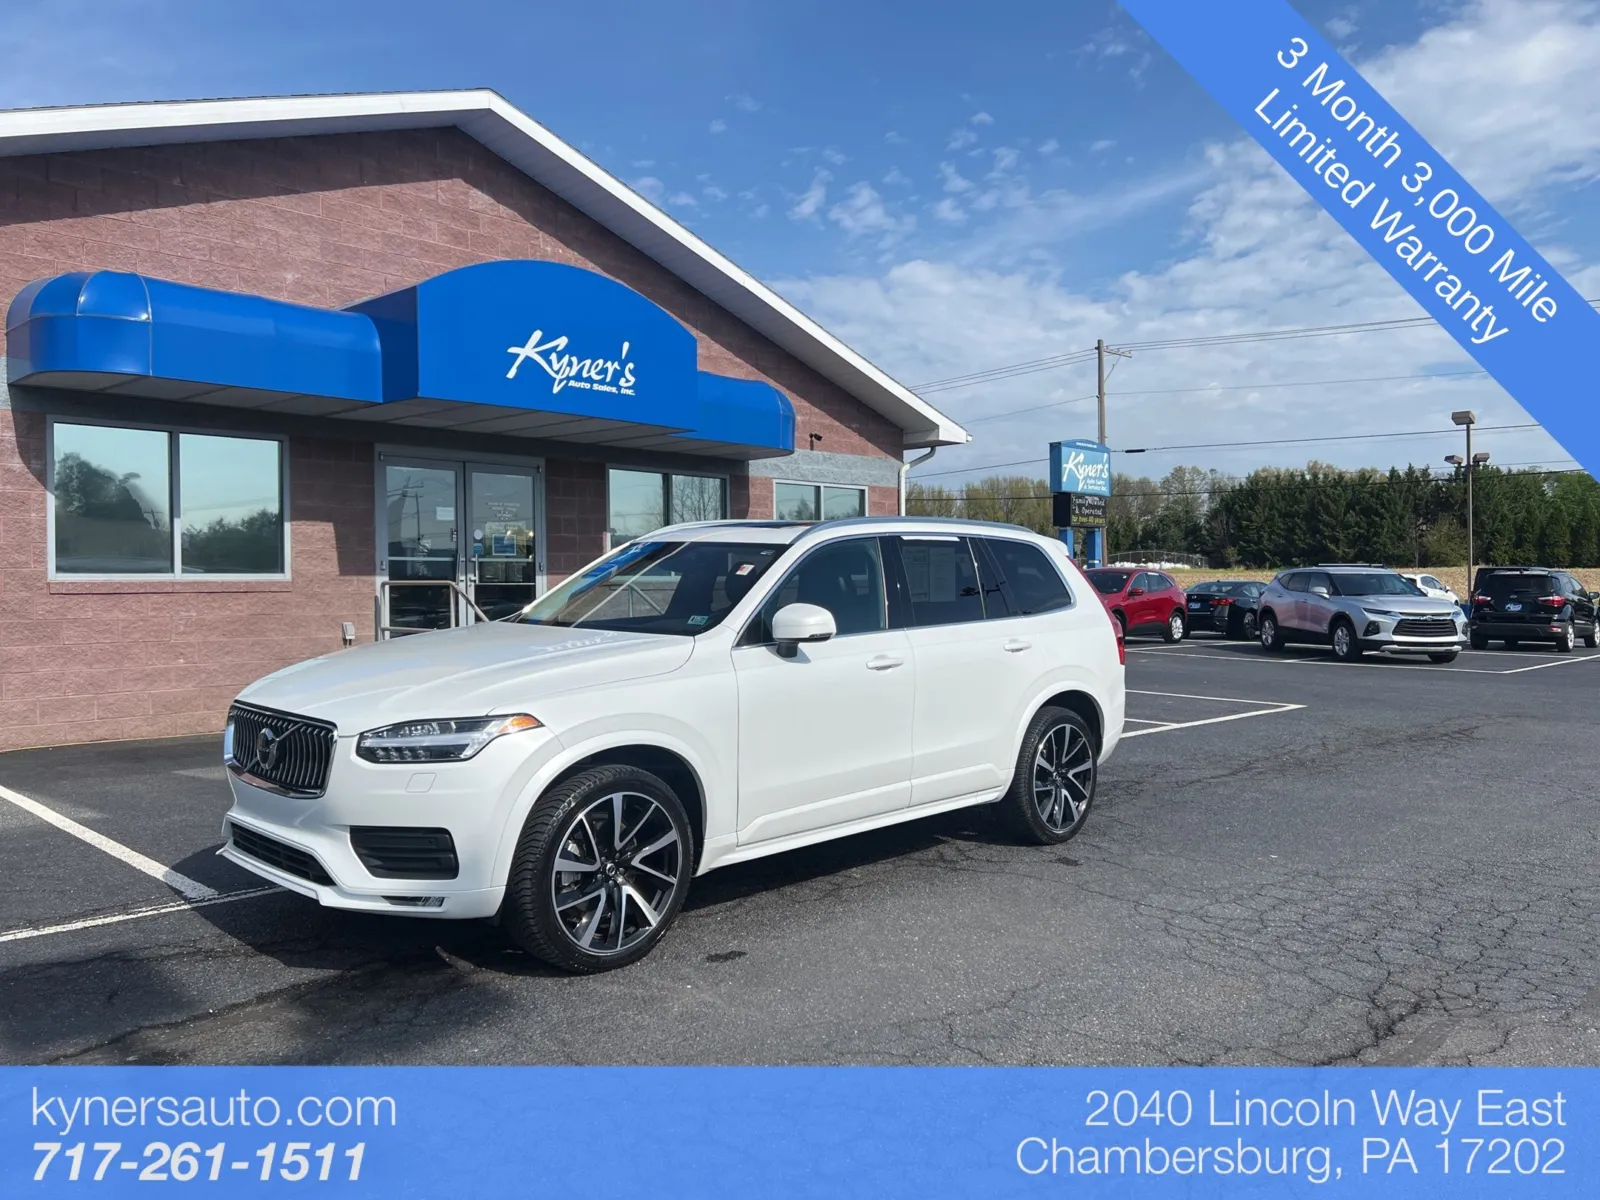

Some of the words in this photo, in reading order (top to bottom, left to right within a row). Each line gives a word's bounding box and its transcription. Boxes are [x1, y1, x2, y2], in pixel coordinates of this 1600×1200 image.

[506, 329, 636, 394] Kyner's
[568, 380, 591, 389] Auto
[592, 383, 619, 394] Sales,
[620, 387, 636, 396] Inc.
[1062, 451, 1109, 492] Kyner's
